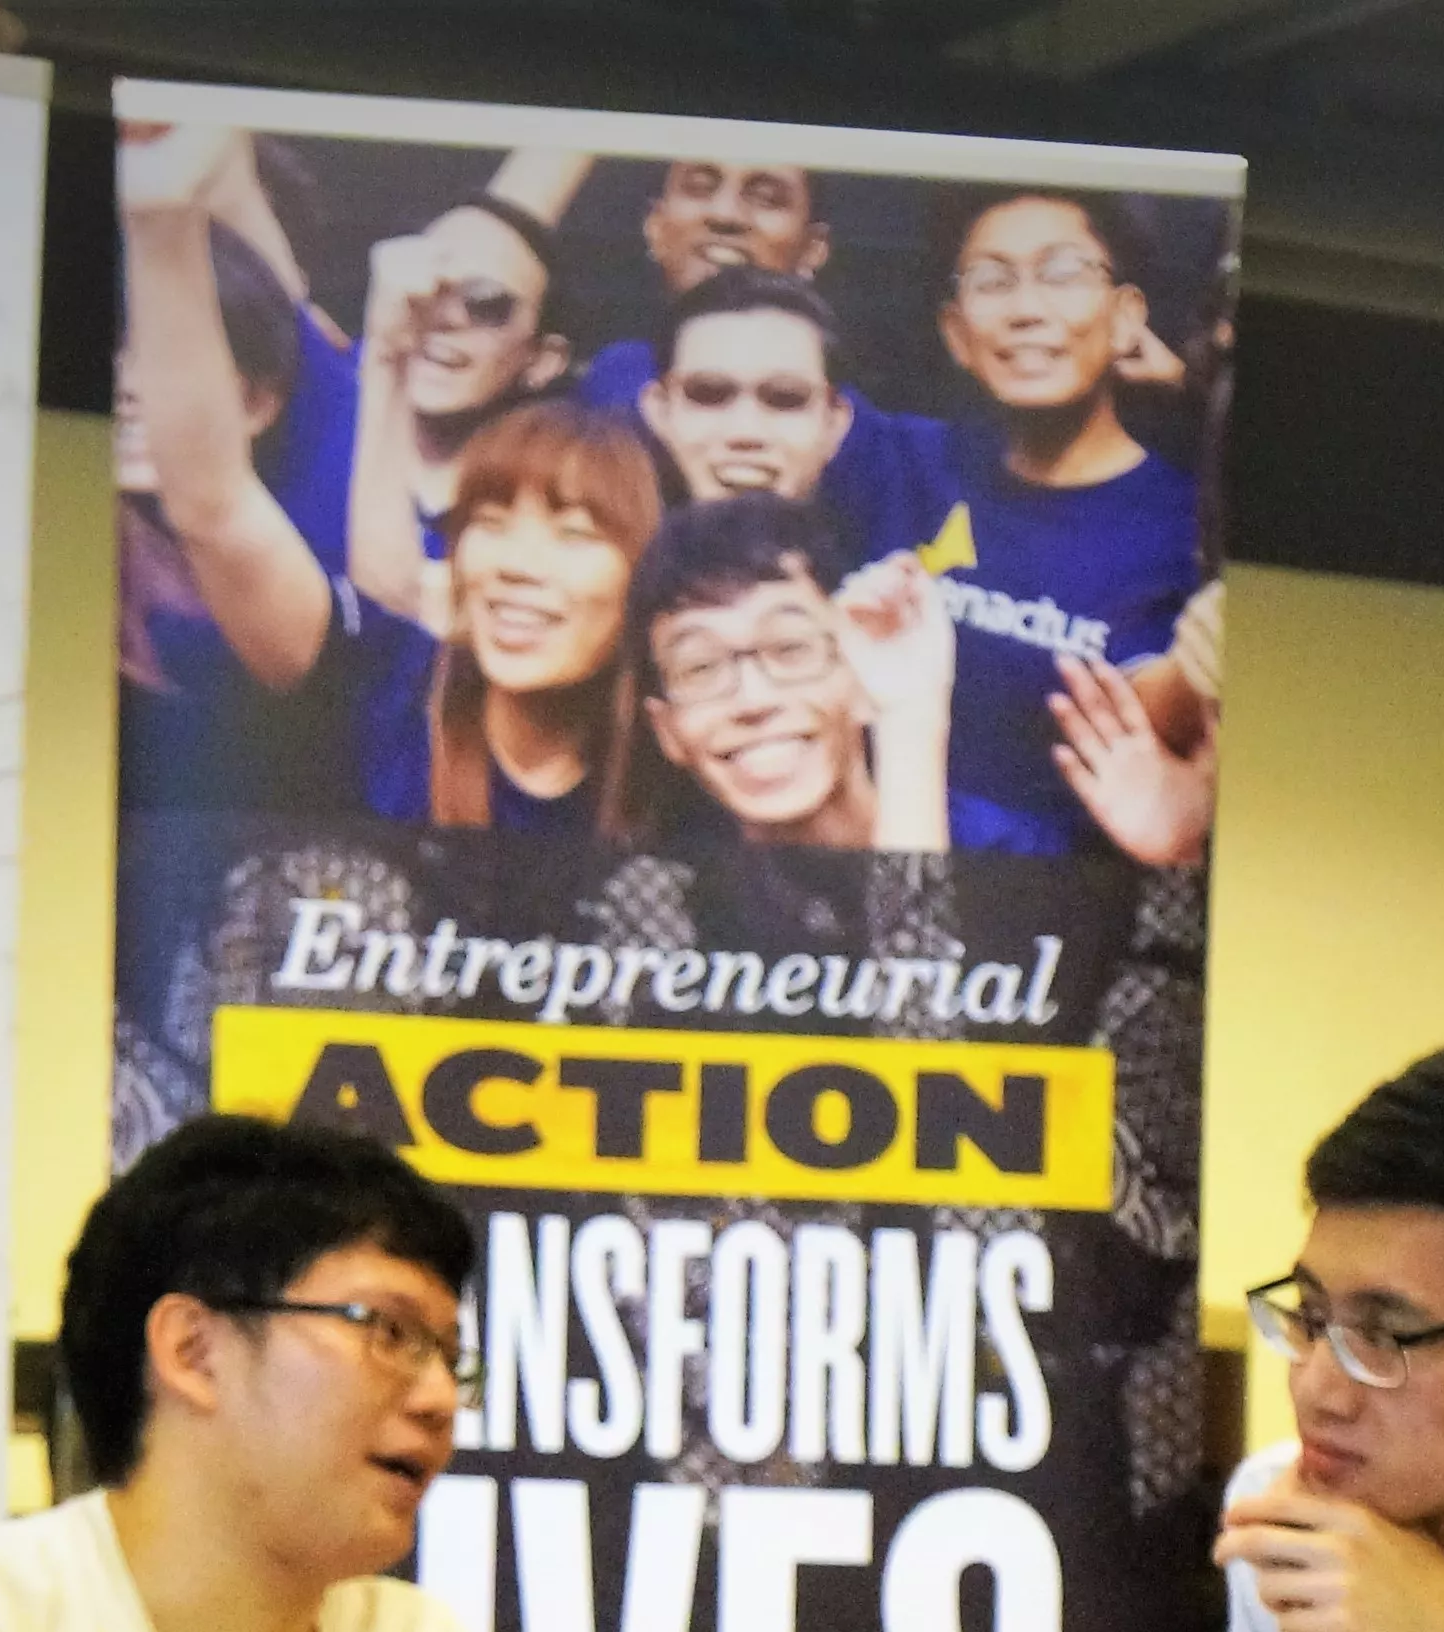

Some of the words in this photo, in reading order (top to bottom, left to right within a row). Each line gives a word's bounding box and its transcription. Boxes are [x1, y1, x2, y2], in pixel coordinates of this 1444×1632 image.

[271, 897, 1063, 1026] Entrepreneurial
[286, 1041, 1047, 1175] ACTION
[453, 1210, 1053, 1473] NSFORMS
